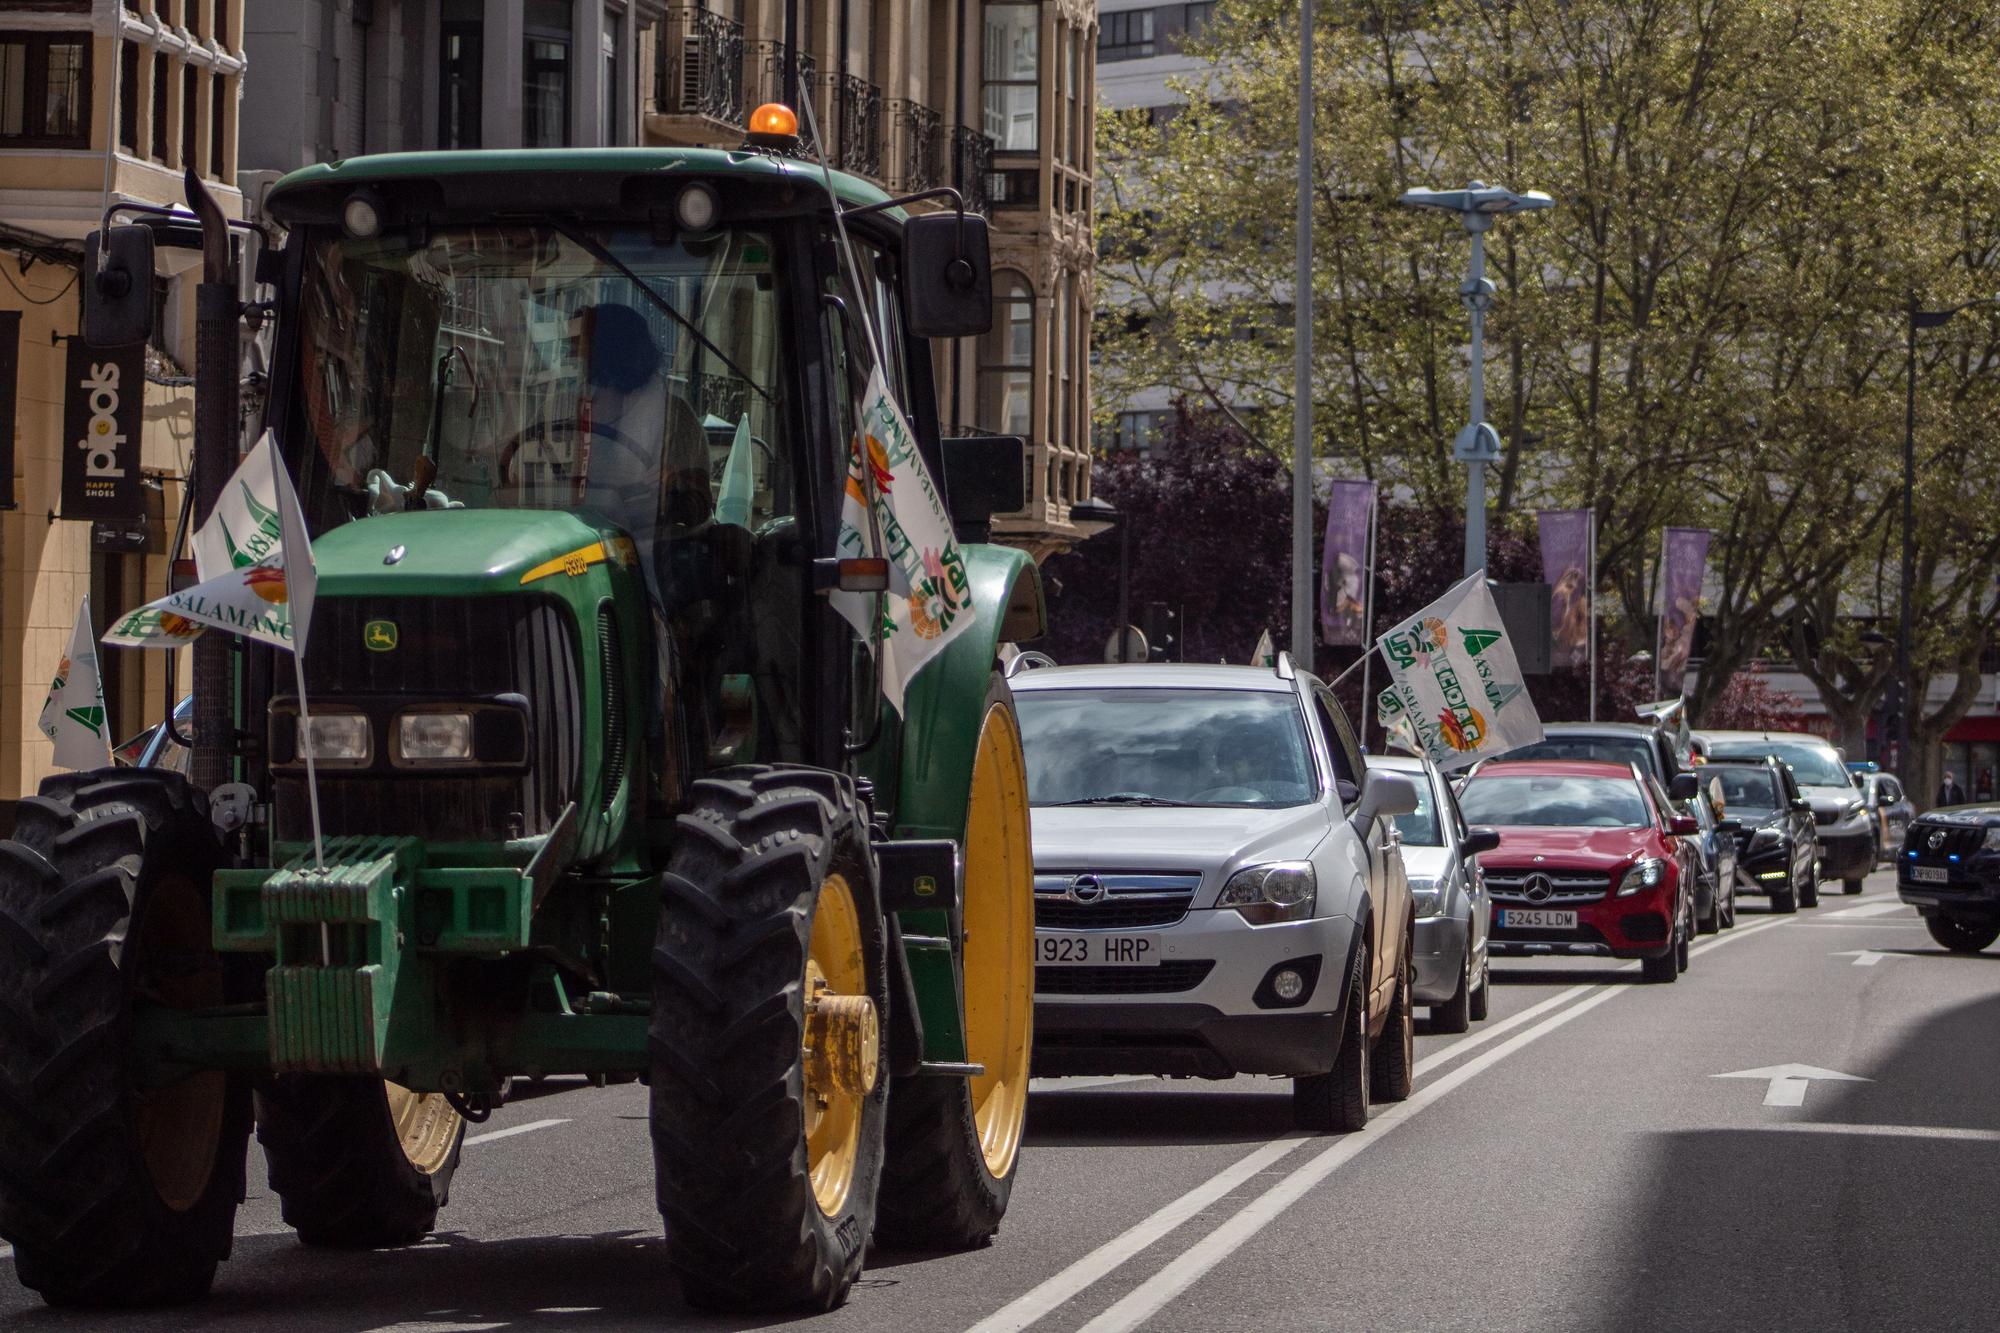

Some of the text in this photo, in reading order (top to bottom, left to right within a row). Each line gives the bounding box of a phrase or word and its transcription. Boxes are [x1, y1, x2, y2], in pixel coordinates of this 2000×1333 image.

[86, 481, 115, 489] HAPPY
[86, 489, 115, 497] SHOES
[169, 592, 293, 641] SALAMANC
[1388, 631, 1417, 670] UPA
[1473, 654, 1504, 711] ASAJA
[1401, 685, 1444, 766] SALAMANCA
[1507, 911, 1573, 927] 5245 LDM
[1034, 938, 1150, 962] 1923 HRP
